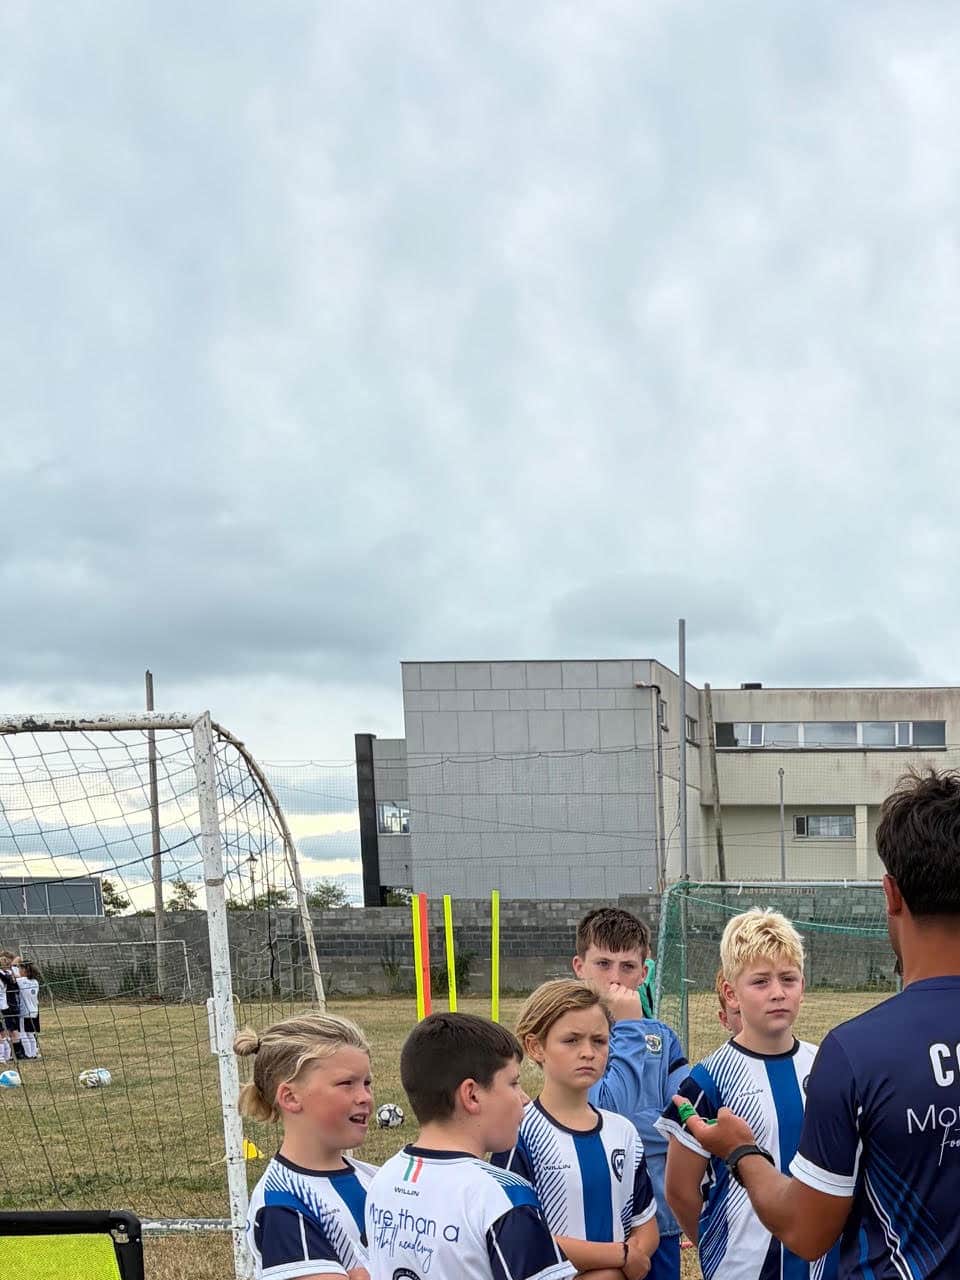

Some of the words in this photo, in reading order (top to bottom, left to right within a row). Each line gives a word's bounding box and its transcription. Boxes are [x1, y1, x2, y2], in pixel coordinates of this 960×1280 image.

[394, 1186, 420, 1197] WILLIN
[398, 1208, 437, 1238] than
[442, 1225, 460, 1243] a
